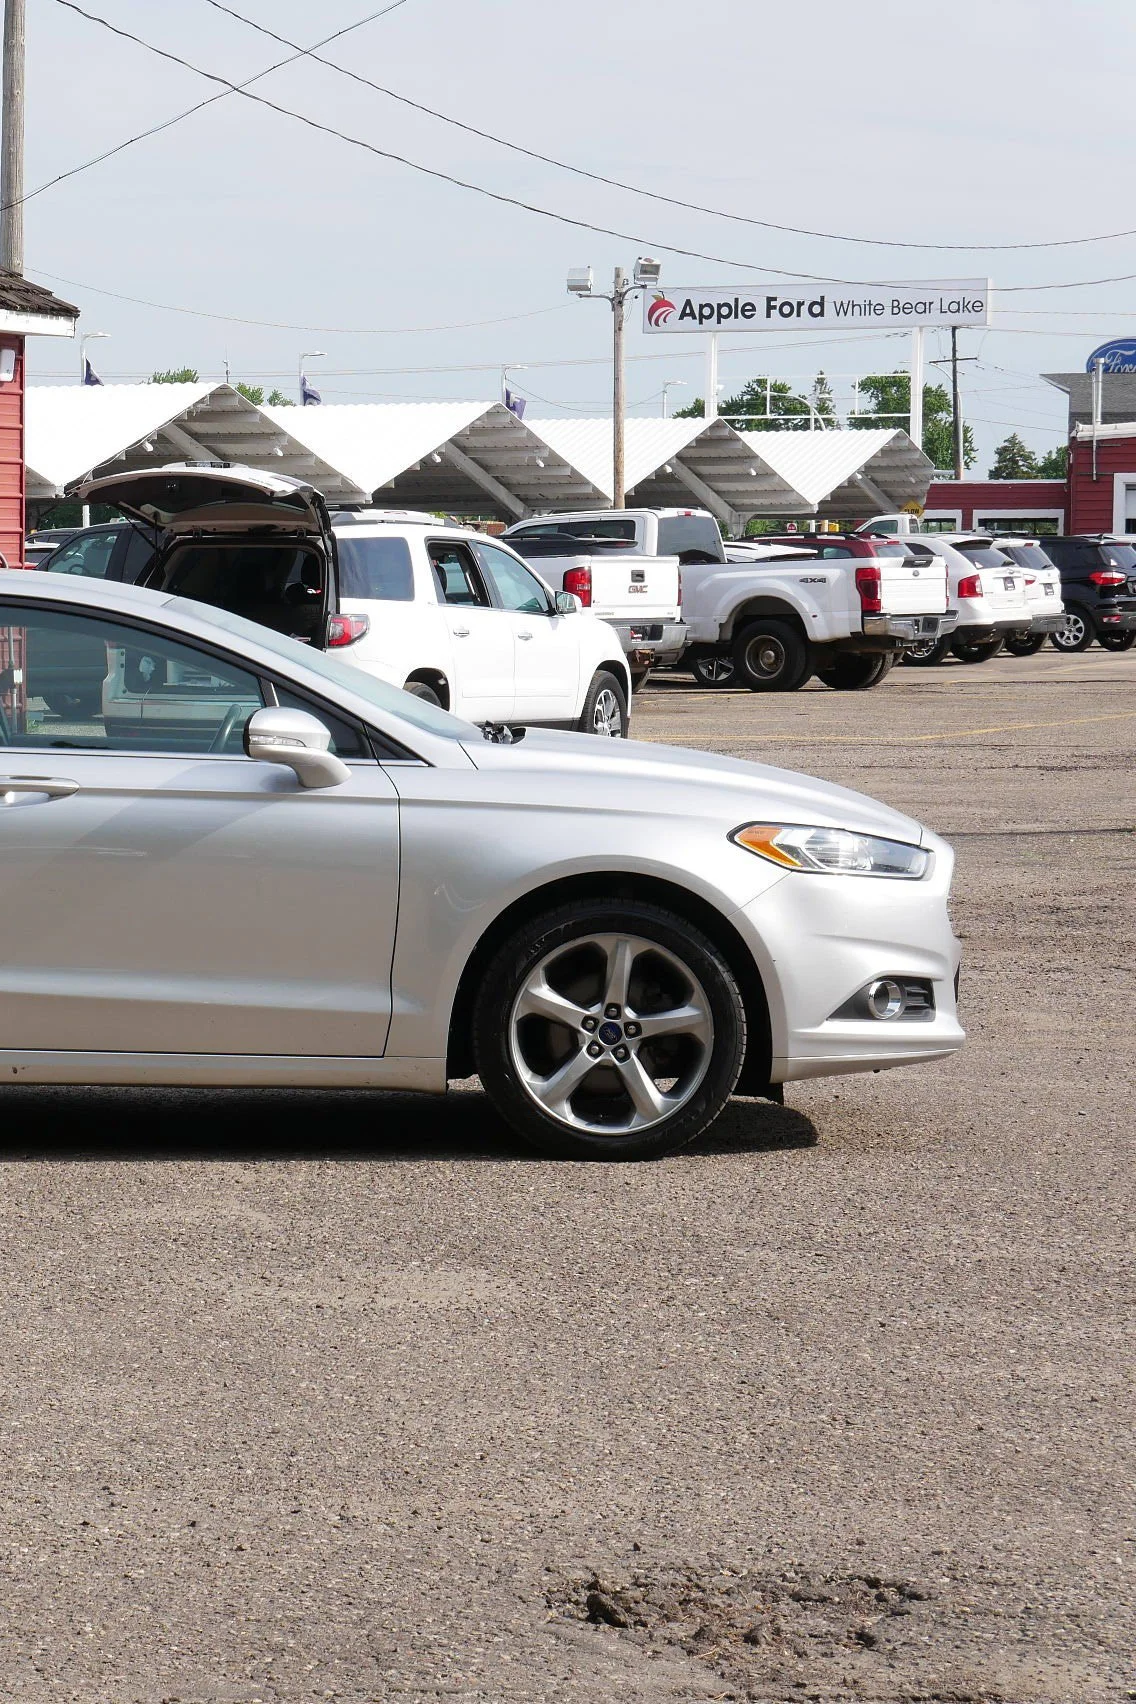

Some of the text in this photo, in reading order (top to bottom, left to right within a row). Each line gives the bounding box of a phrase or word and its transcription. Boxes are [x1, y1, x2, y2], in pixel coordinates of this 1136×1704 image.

[678, 296, 984, 325] Apple Ford White Bear Lake
[628, 585, 649, 594] GMC
